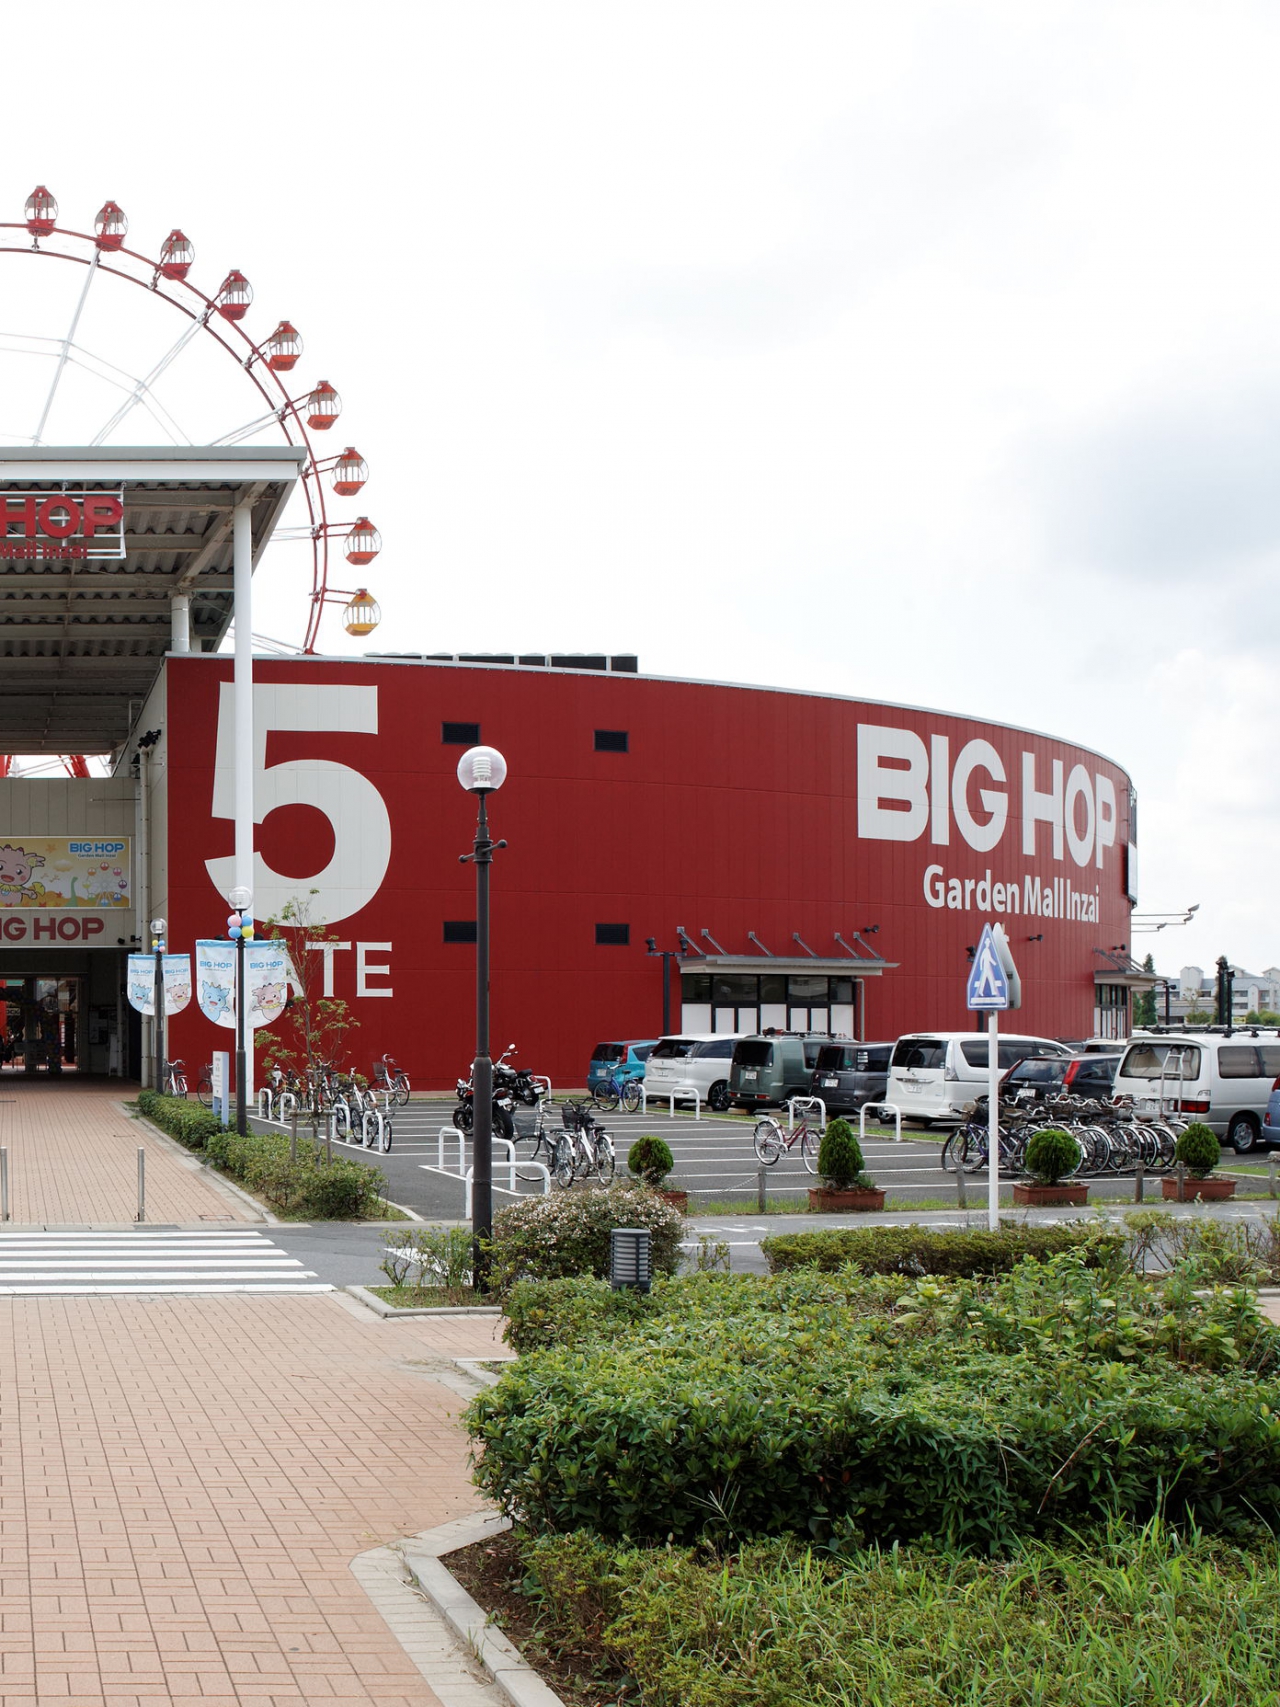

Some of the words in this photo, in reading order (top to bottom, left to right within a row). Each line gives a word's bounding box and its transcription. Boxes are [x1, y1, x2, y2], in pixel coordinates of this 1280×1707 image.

[42, 542, 89, 560] Inzai
[204, 681, 392, 928] 5
[857, 723, 1009, 853] BIG
[1022, 751, 1117, 870] HOP
[70, 843, 92, 853] BIG
[95, 843, 124, 853] HOP
[923, 864, 1020, 914] Garden
[1024, 874, 1065, 920] Mall
[1066, 879, 1100, 924] Inzai
[34, 917, 104, 941] HOP
[266, 960, 283, 968] HOP
